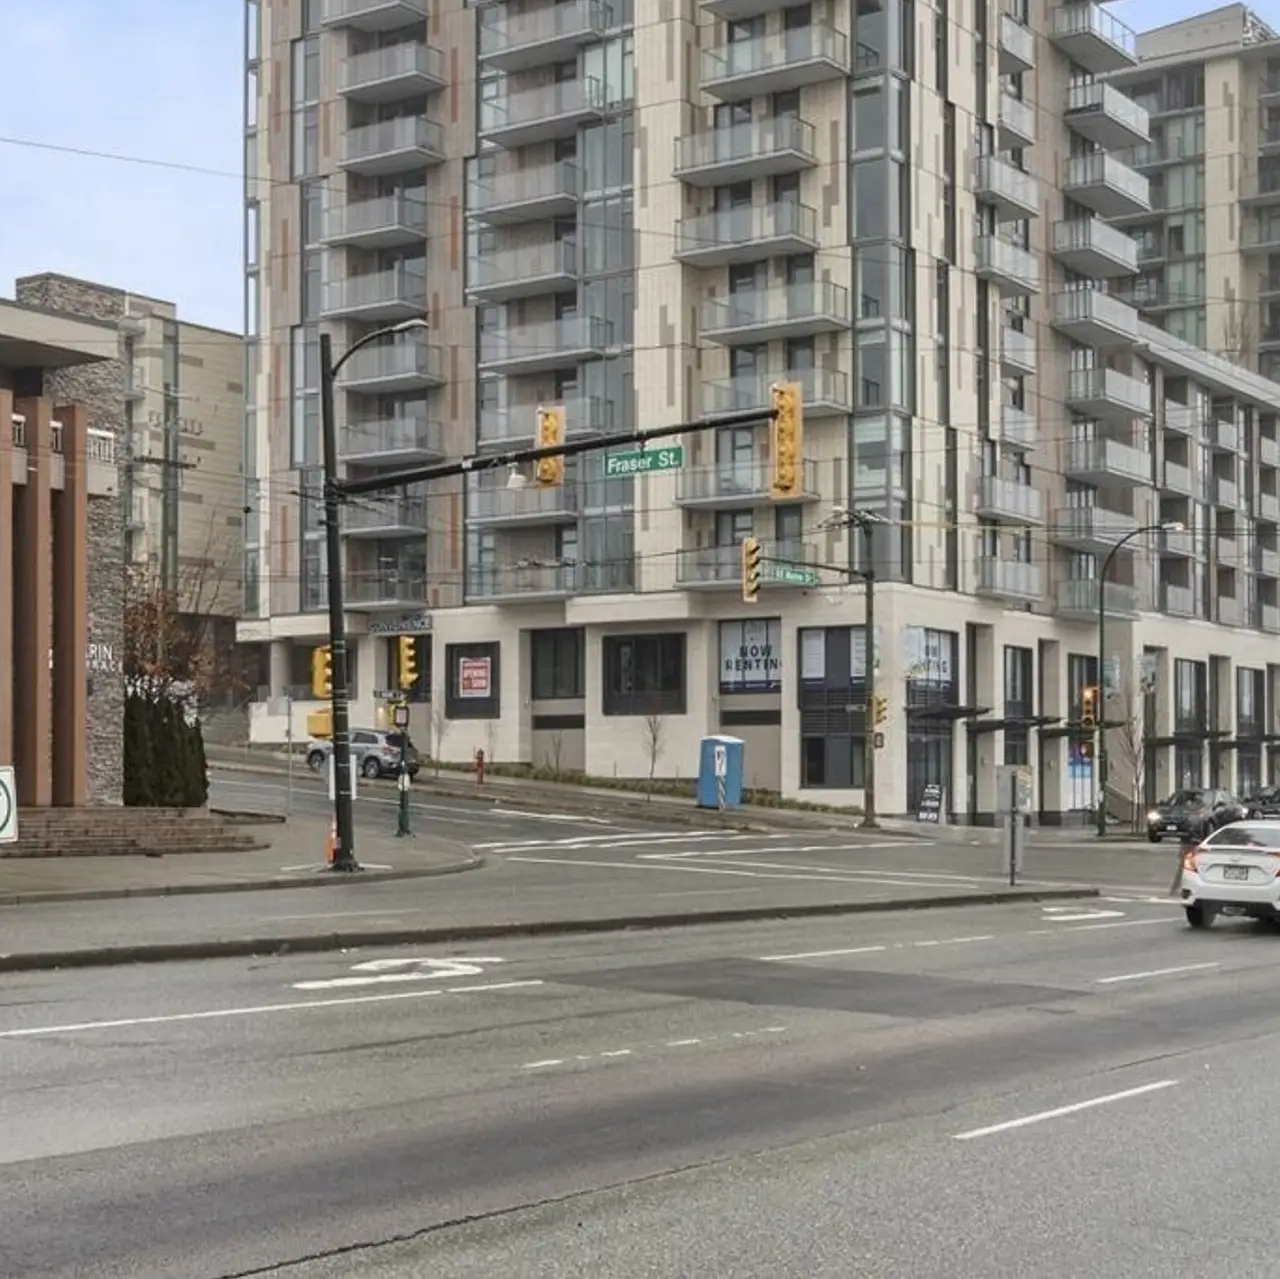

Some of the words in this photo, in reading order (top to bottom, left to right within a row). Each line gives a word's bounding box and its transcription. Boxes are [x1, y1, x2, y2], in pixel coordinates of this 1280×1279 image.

[607, 456, 652, 474] Fraser
[740, 644, 773, 658] NOW
[725, 658, 782, 672] RENTIN
